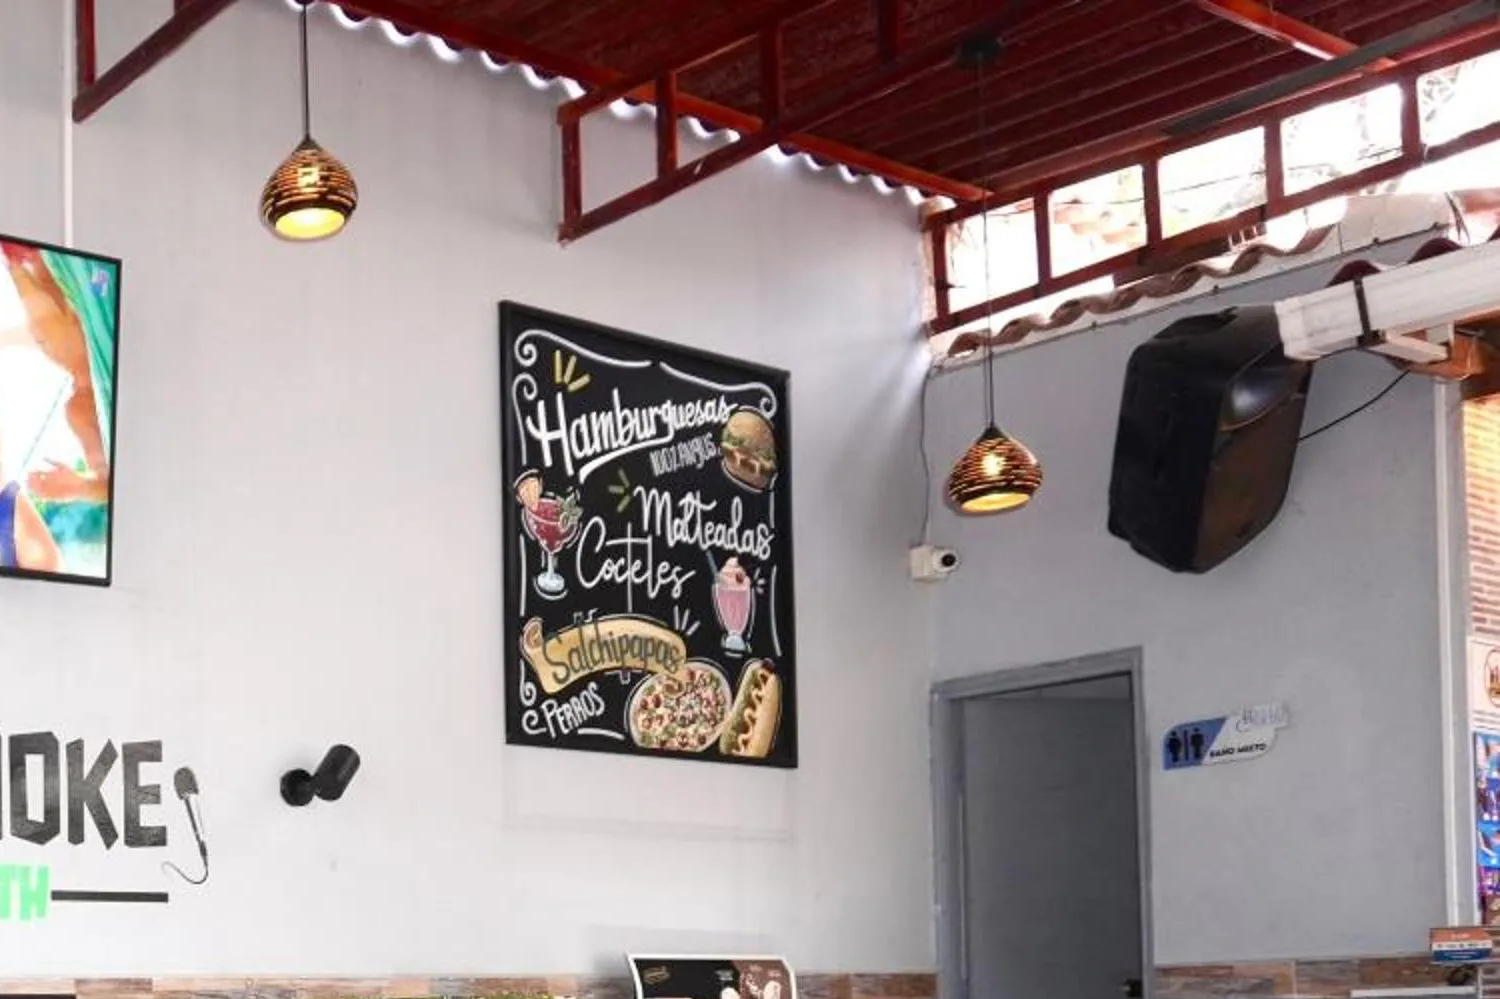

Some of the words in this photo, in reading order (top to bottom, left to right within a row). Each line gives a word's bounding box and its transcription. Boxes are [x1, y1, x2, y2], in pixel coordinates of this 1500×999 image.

[526, 387, 738, 484] Hamburguesas
[576, 516, 696, 613] Cocteles
[541, 681, 605, 739] PERROS
